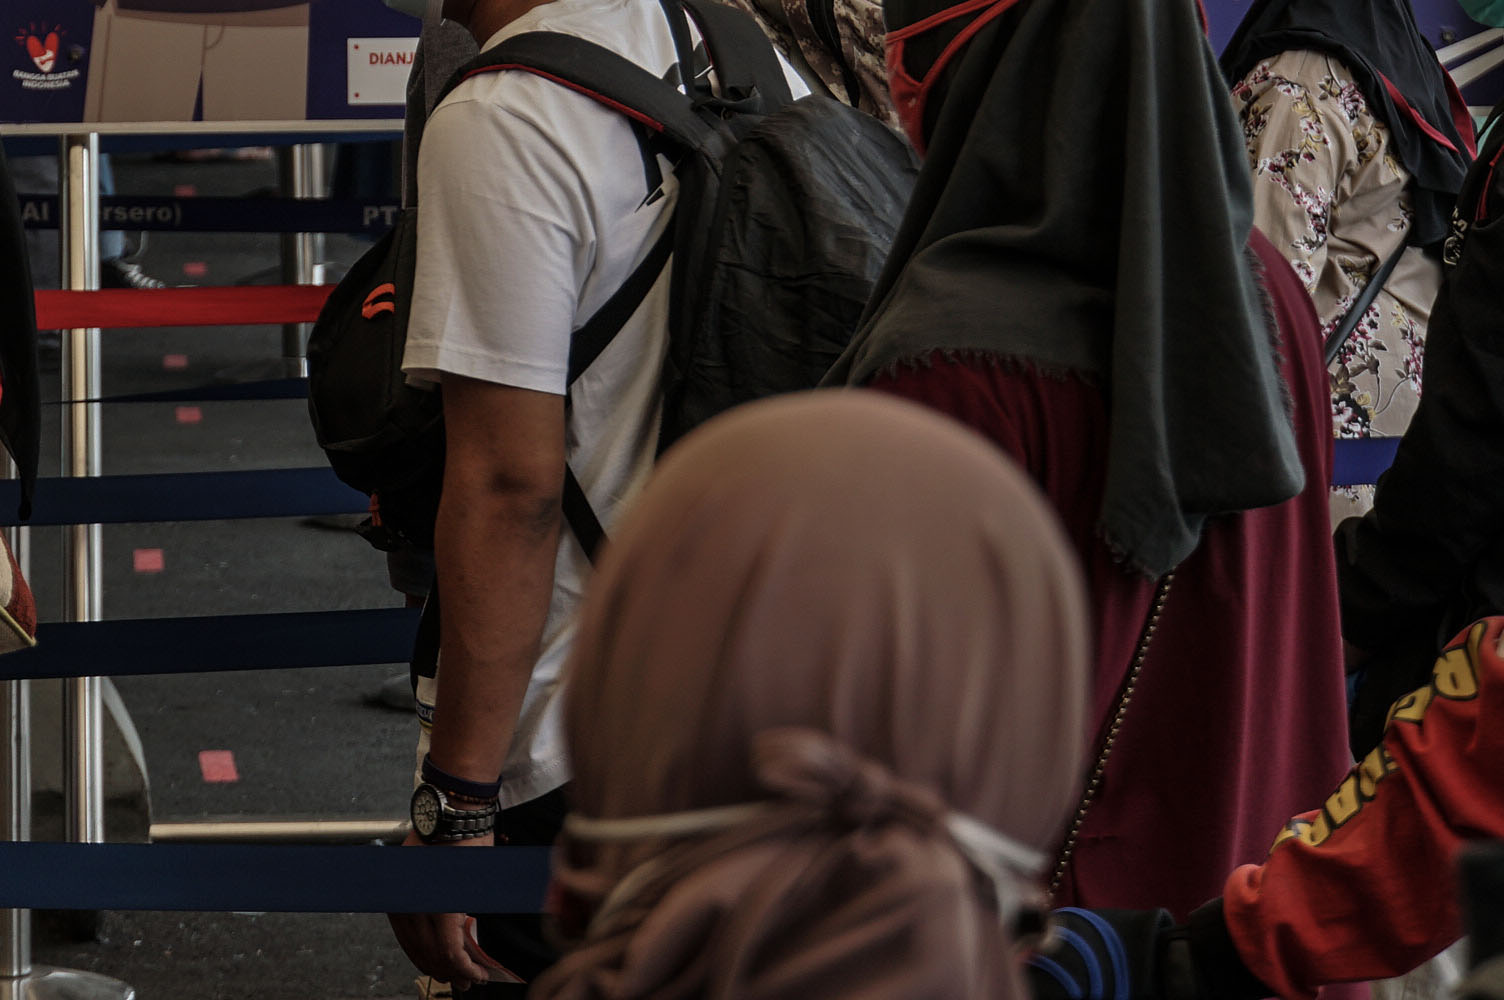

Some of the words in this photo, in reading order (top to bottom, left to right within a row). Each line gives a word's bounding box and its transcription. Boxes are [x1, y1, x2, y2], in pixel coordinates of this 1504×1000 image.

[369, 52, 416, 65] DIANJ
[22, 201, 50, 221] AI
[102, 201, 182, 227] rsero)
[362, 204, 397, 226] PT
